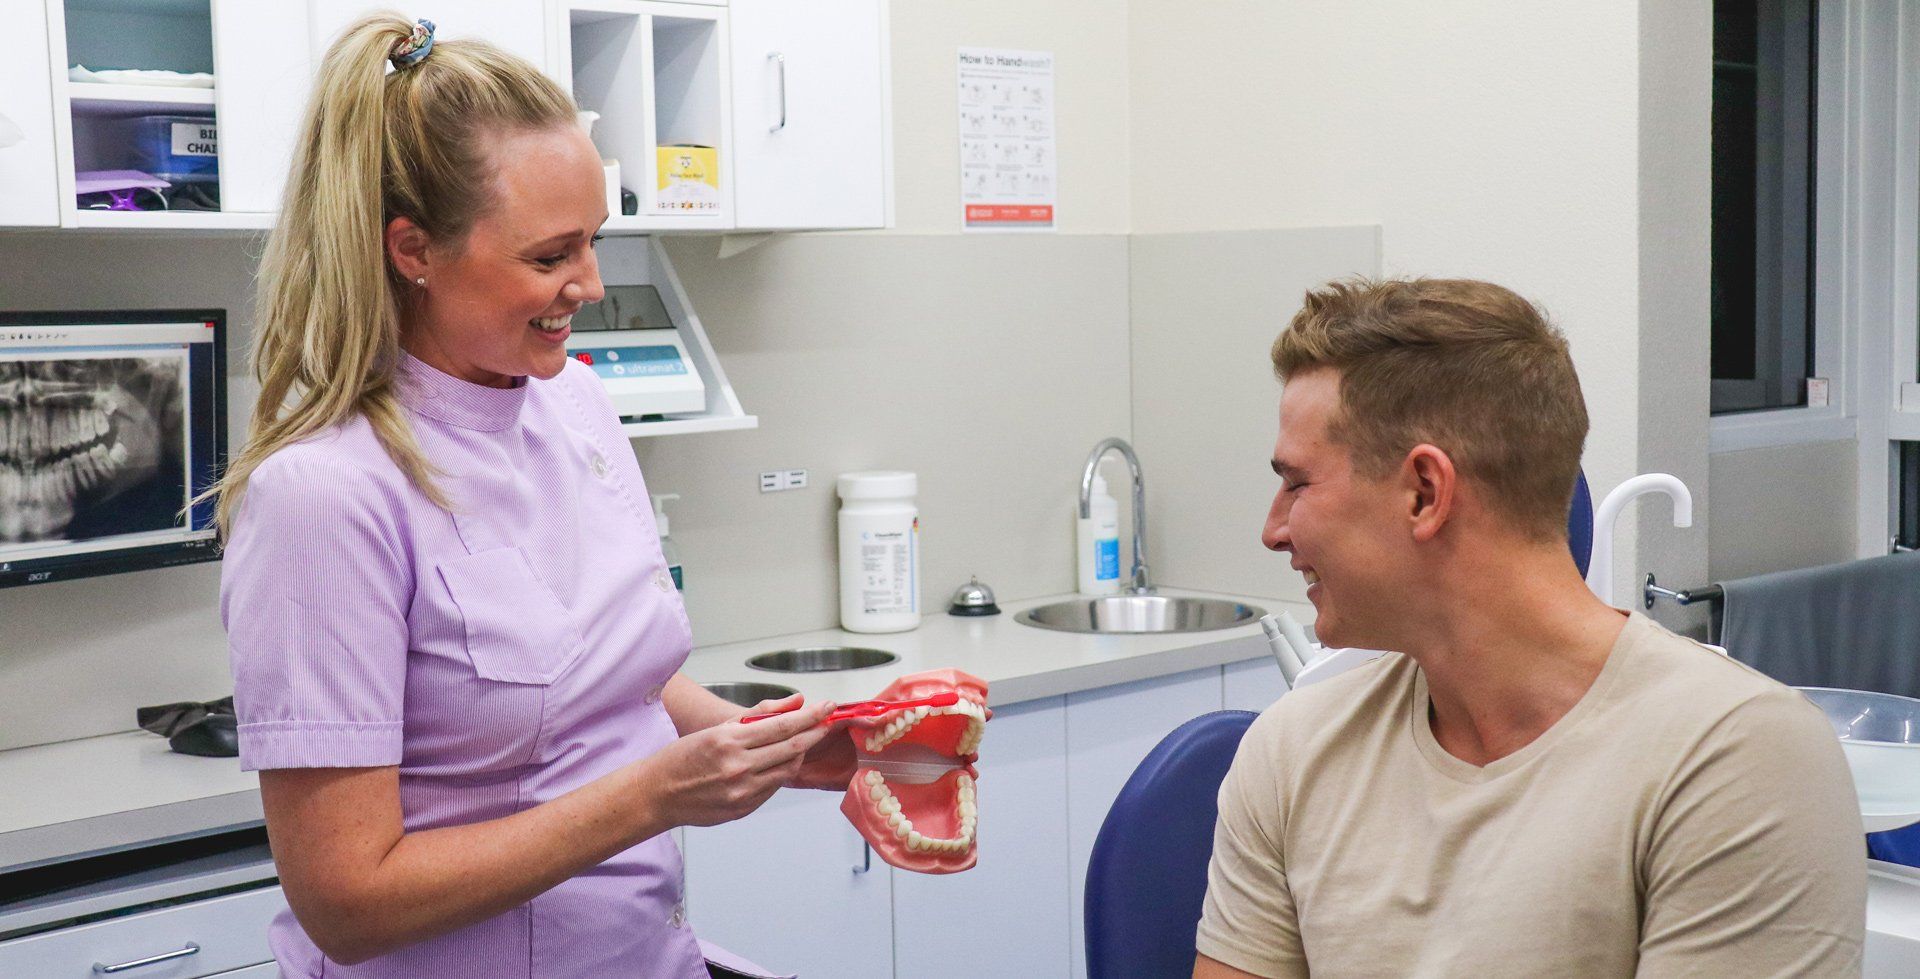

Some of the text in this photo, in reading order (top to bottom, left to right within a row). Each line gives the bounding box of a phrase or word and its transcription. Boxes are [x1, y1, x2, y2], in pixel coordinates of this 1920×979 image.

[959, 53, 981, 64] How
[984, 56, 995, 65] to
[28, 572, 51, 581] acer
